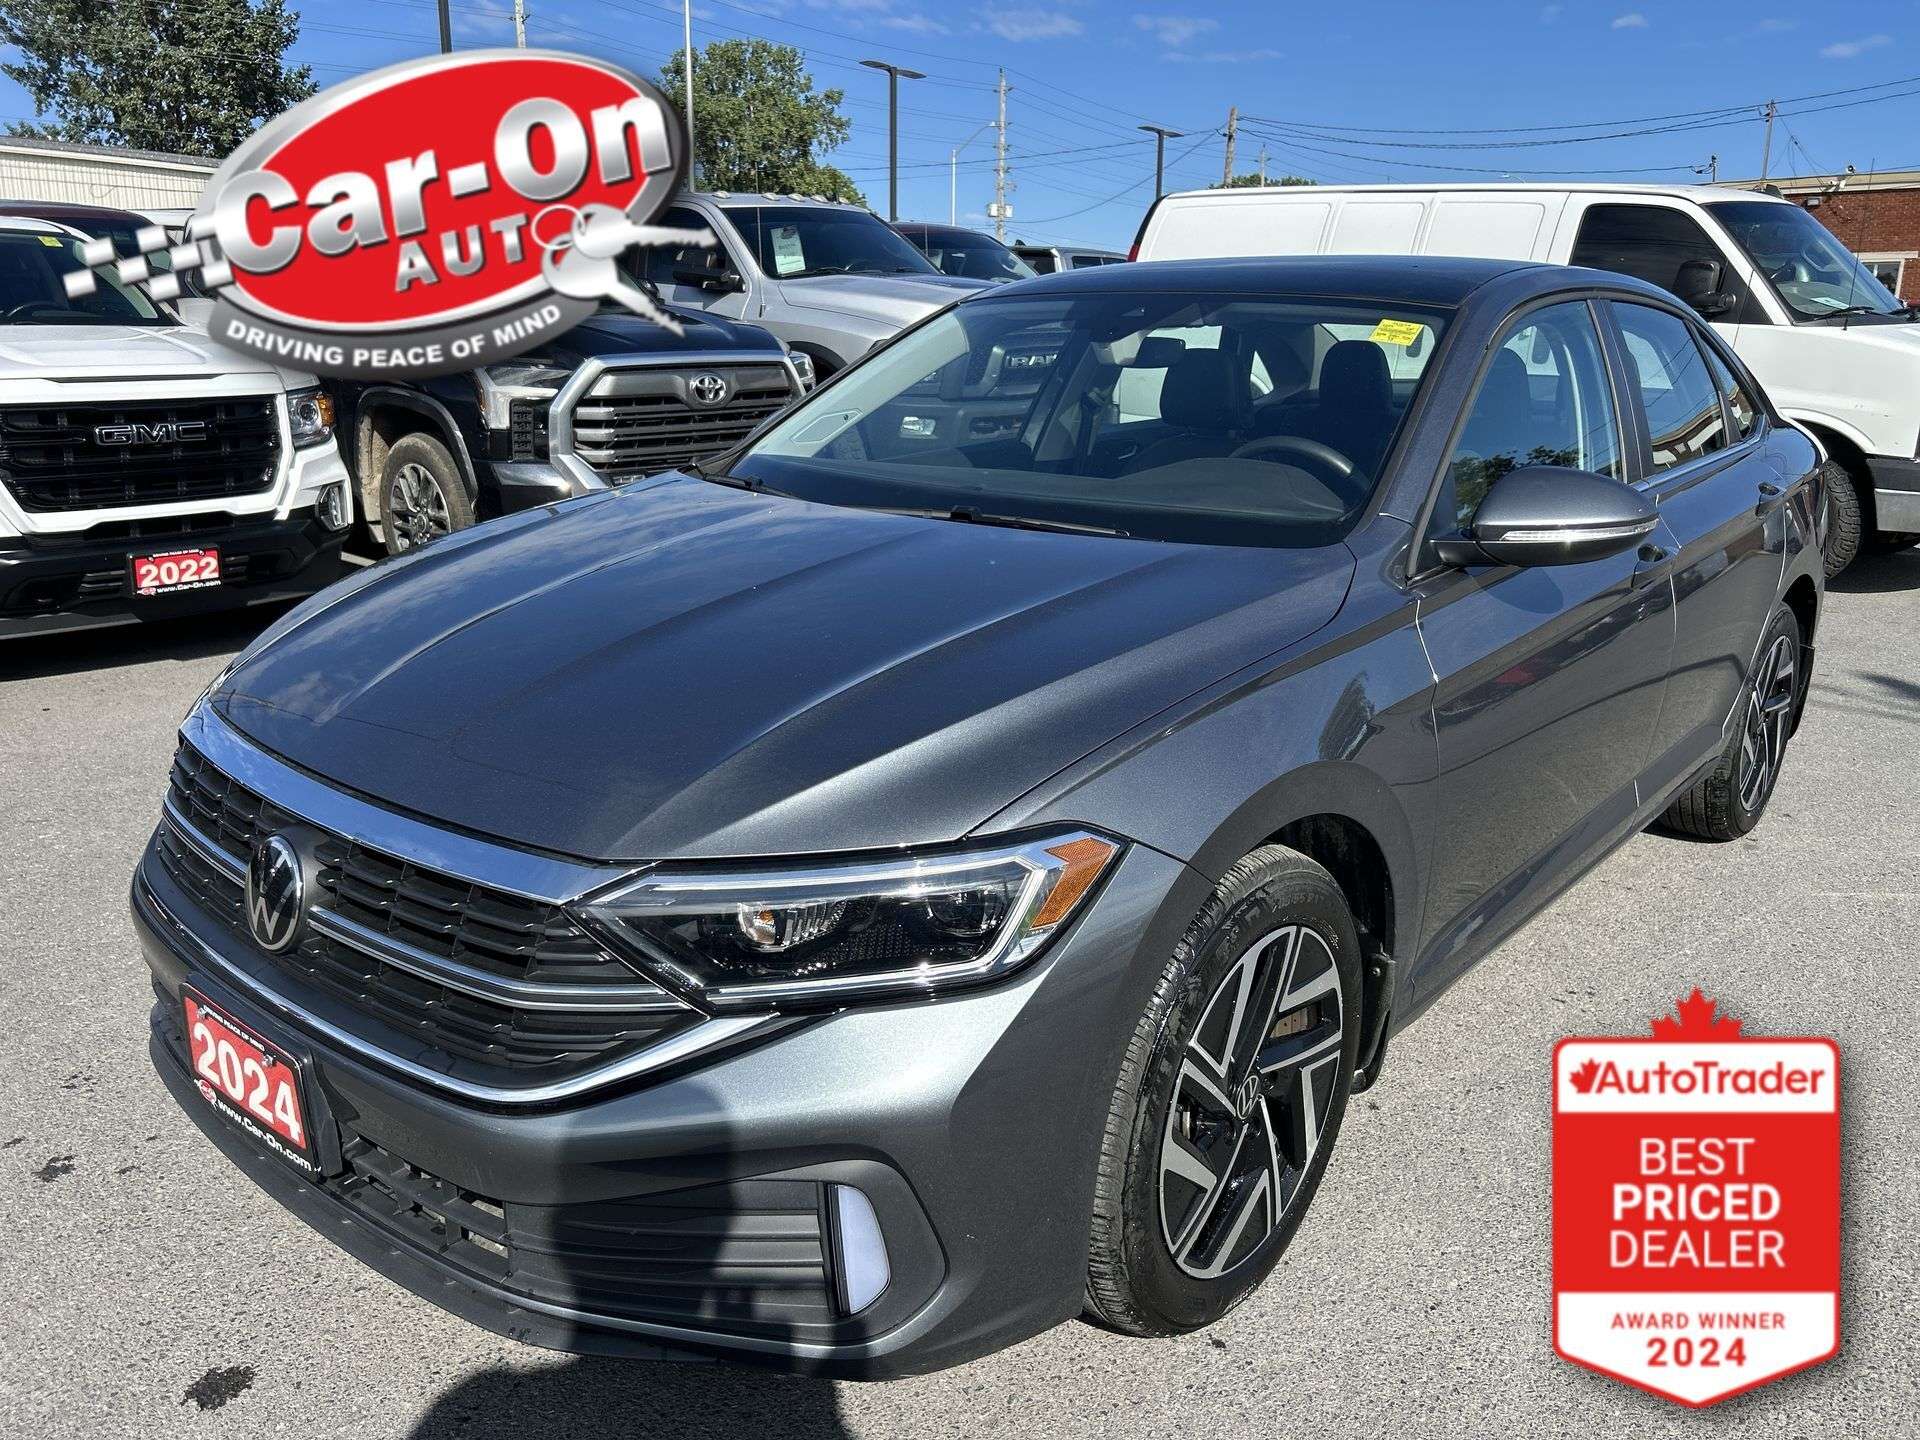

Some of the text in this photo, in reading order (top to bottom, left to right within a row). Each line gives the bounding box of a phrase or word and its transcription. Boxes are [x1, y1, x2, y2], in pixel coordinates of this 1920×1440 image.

[94, 421, 206, 445] GMC
[140, 556, 219, 588] 2022
[193, 1022, 302, 1140] 2024
[217, 1099, 312, 1172] www.Car-On.com
